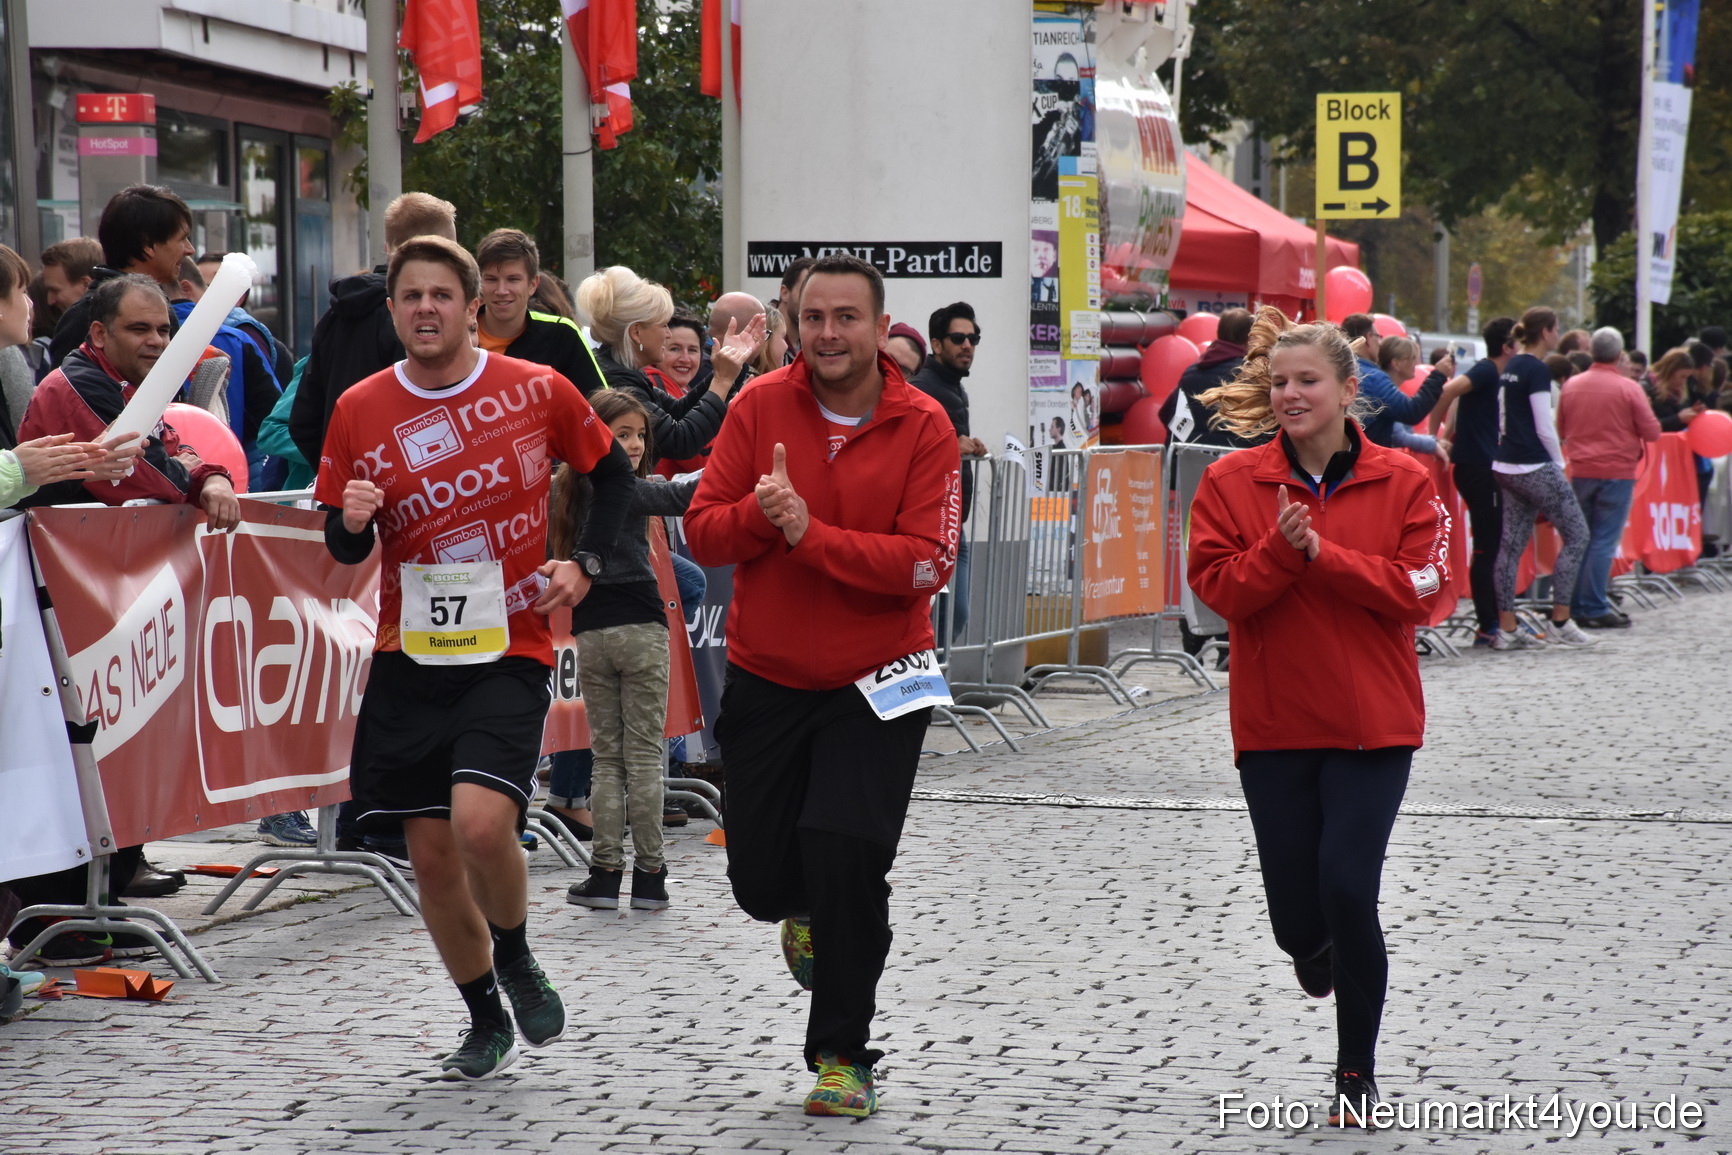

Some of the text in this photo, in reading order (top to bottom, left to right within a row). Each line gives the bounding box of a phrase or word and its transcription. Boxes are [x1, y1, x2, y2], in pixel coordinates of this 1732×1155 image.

[1041, 95, 1058, 110] CUP
[1327, 99, 1391, 121] Block
[90, 139, 129, 150] HotSpot
[1338, 131, 1379, 191] B
[398, 411, 446, 438] raumbox
[471, 415, 530, 447] schenken
[408, 489, 513, 541] wohnen outdoor
[435, 525, 484, 550] raumbox
[433, 573, 470, 583] BOCK
[430, 595, 468, 627] 57
[429, 635, 478, 648] Raimund
[74, 597, 178, 732] AS NEUE
[900, 679, 934, 696] Andreas
